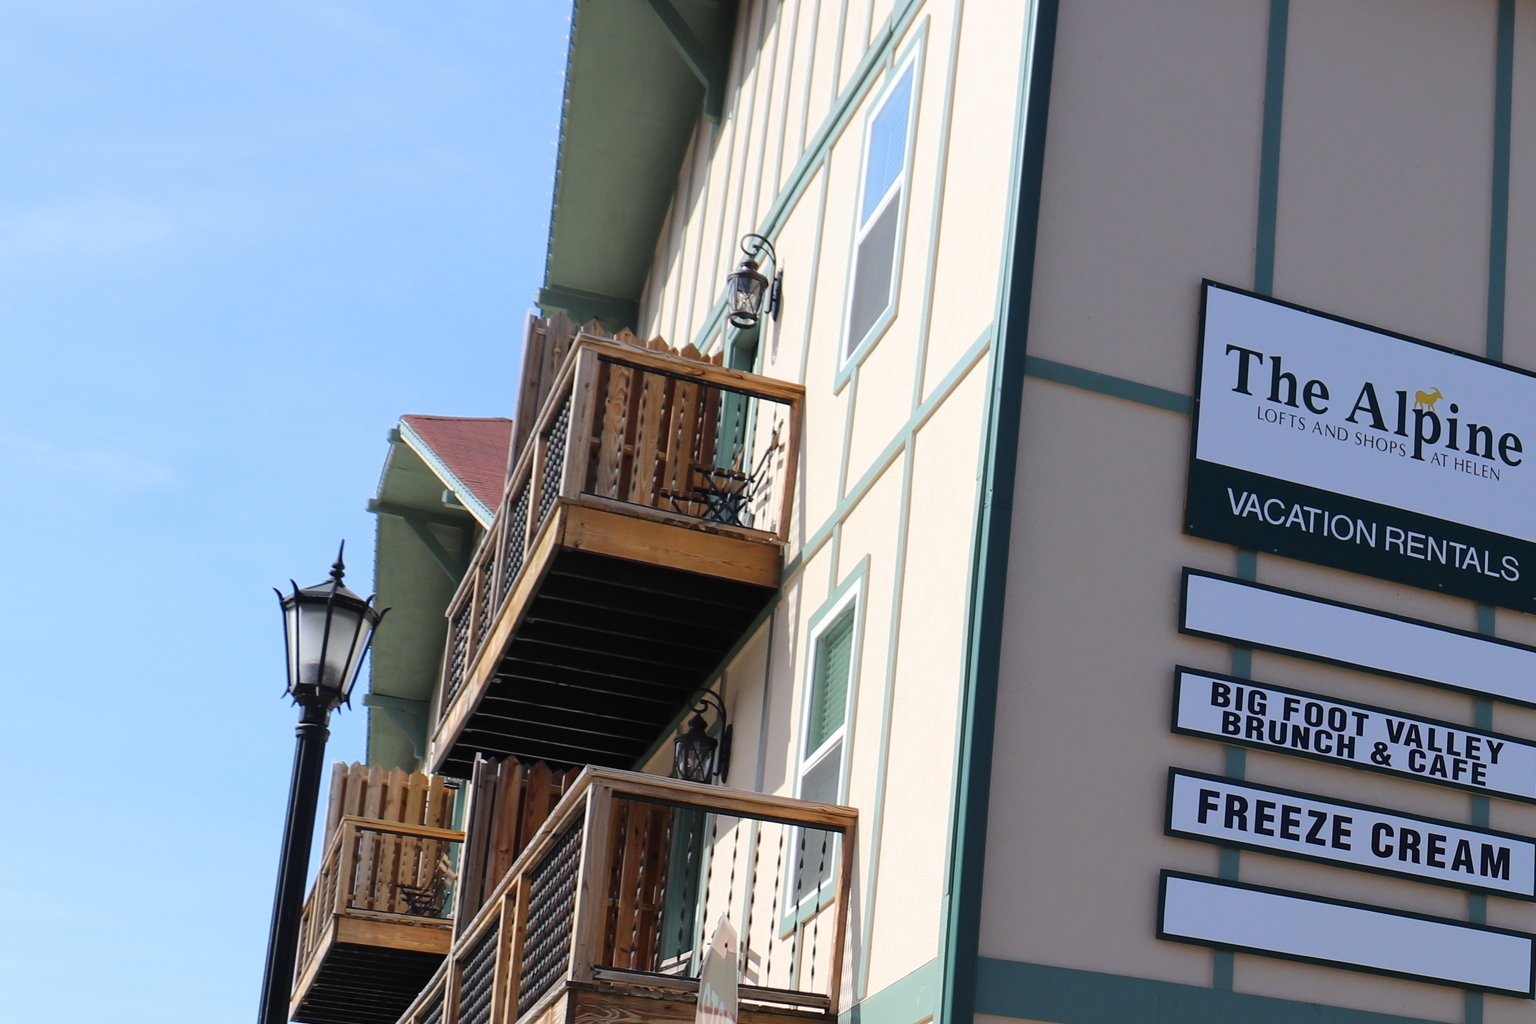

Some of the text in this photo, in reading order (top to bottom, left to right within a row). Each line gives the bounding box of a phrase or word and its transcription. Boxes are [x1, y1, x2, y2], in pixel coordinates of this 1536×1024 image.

[1225, 343, 1523, 468] The Alpine
[1257, 405, 1501, 481] LOFTS AND SHOPS AT HELEN
[1227, 487, 1521, 582] VACATION RENTALS
[1210, 681, 1505, 765] BIG FOOT VALLEY
[1221, 710, 1488, 787] BRUNCH & CAFE
[1197, 788, 1511, 881] FREEZE CREAM
